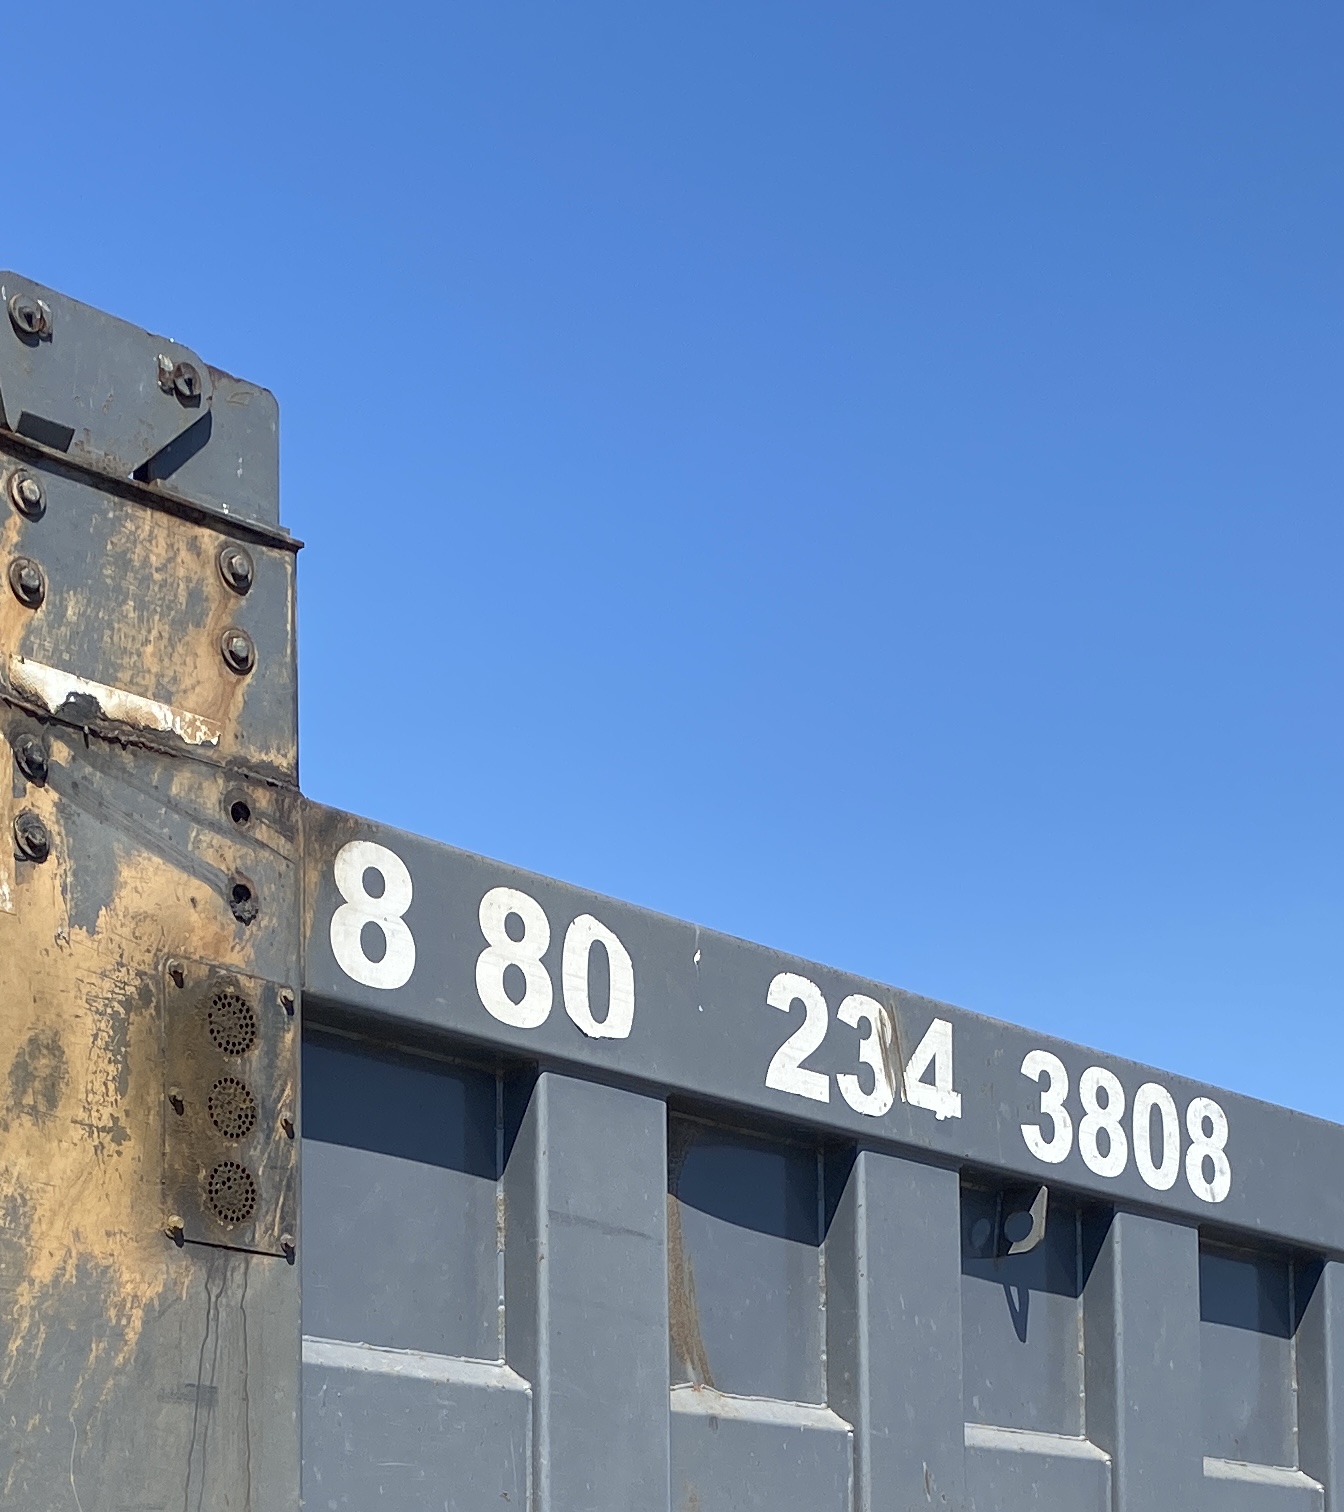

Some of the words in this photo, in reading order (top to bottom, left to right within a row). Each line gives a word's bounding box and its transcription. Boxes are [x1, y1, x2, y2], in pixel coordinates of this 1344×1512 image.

[329, 839, 417, 990] 8
[474, 886, 635, 1040] 80
[764, 971, 962, 1122] 234
[1019, 1049, 1233, 1204] 3808
